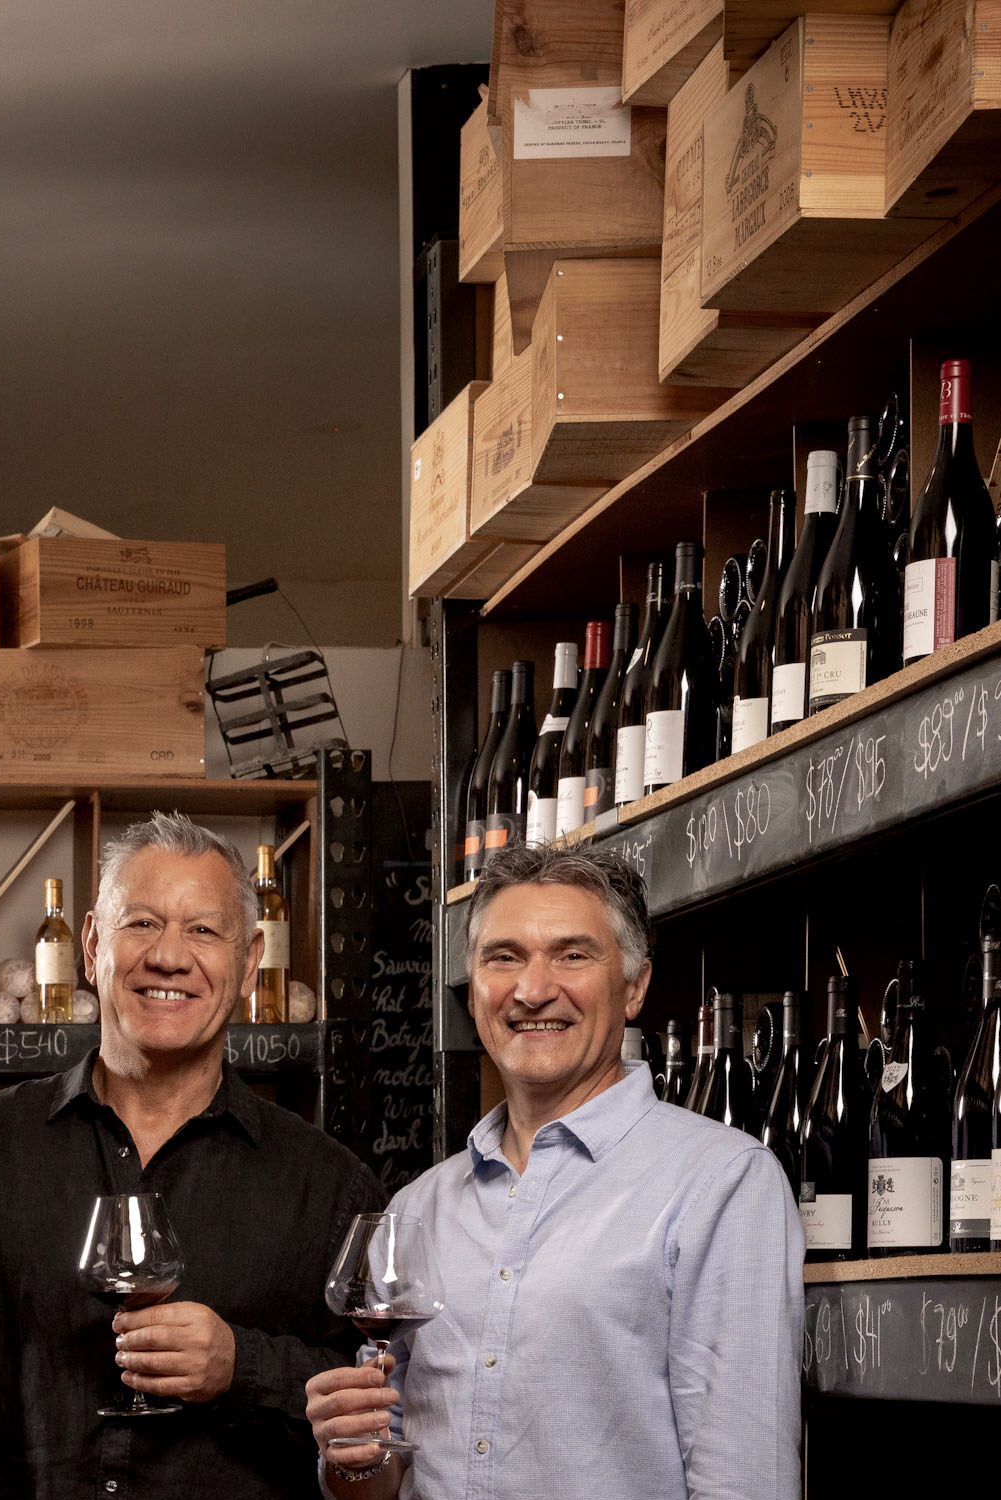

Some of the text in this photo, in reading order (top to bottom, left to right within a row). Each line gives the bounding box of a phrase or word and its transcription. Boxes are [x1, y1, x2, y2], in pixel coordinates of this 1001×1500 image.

[76, 574, 192, 597] CHÂTEAU GUIRAUD
[224, 1033, 301, 1064] $1050
